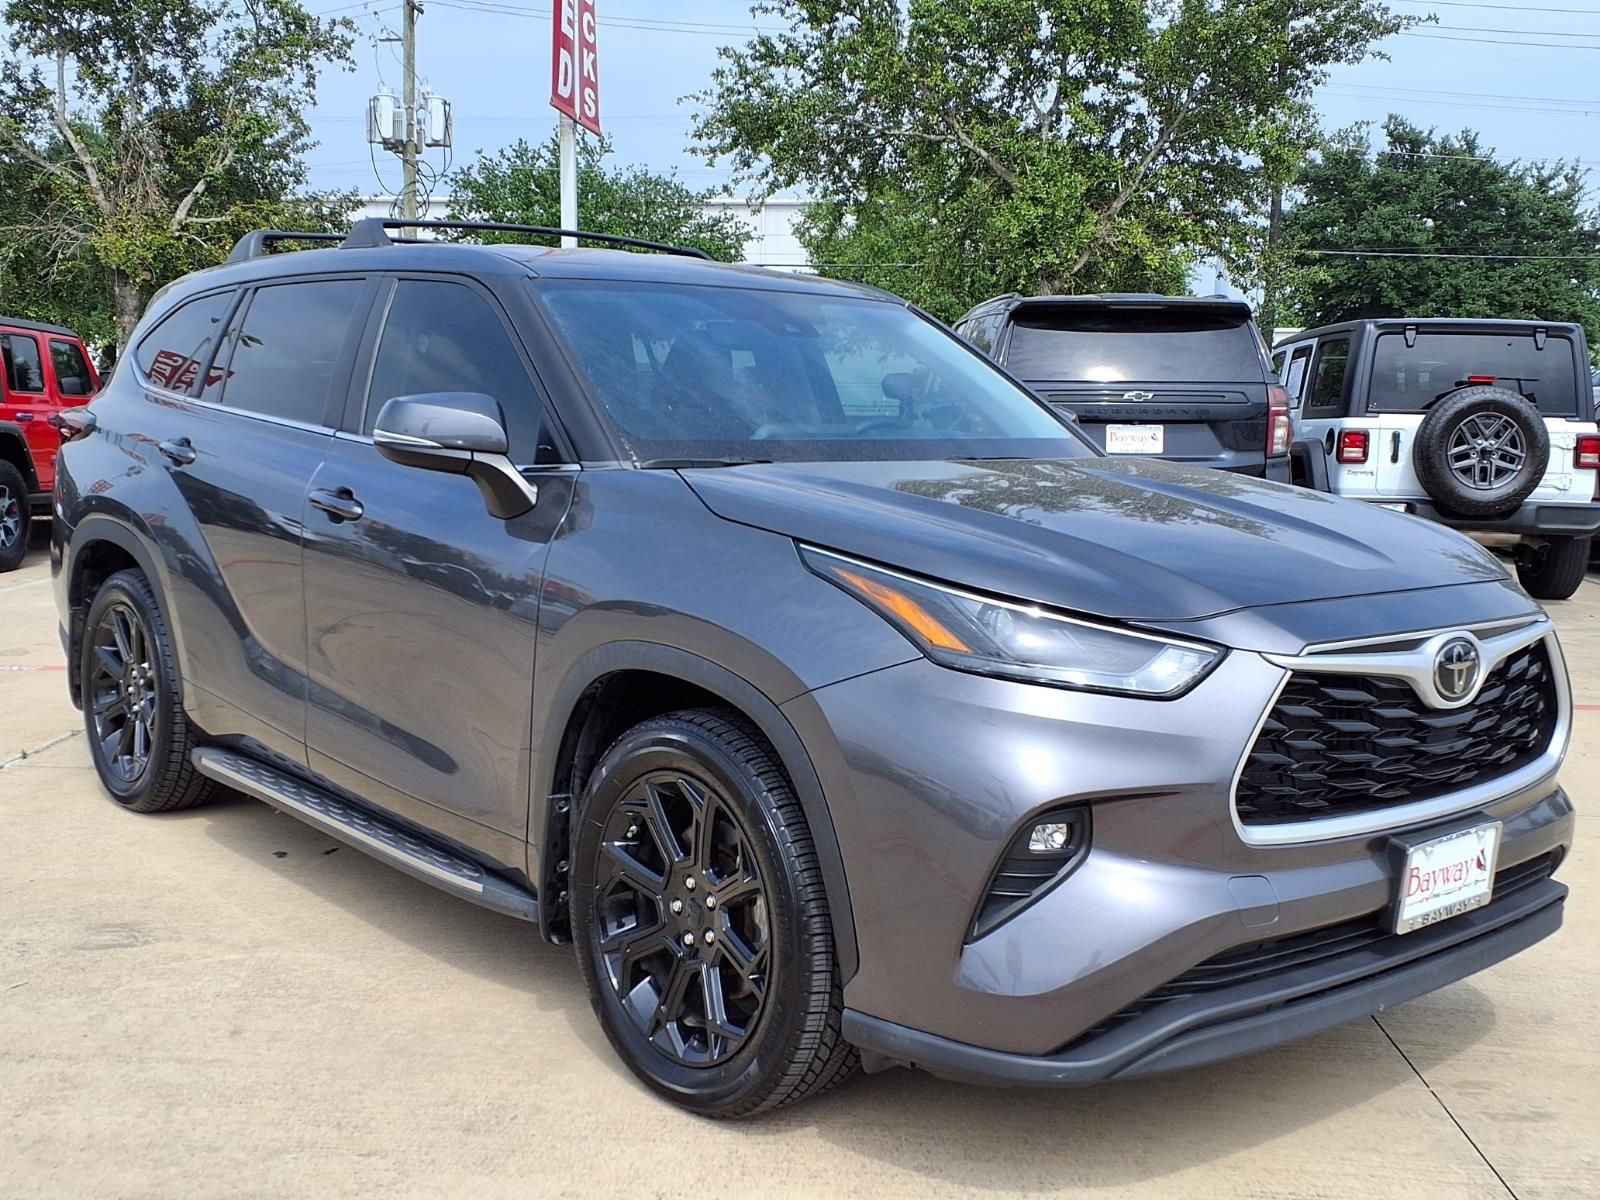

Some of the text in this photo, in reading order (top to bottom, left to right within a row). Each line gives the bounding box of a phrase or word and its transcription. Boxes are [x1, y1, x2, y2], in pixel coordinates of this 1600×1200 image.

[582, 0, 596, 118] CKS
[1405, 858, 1475, 898] Bayway
[1421, 899, 1469, 925] BAYWAY
